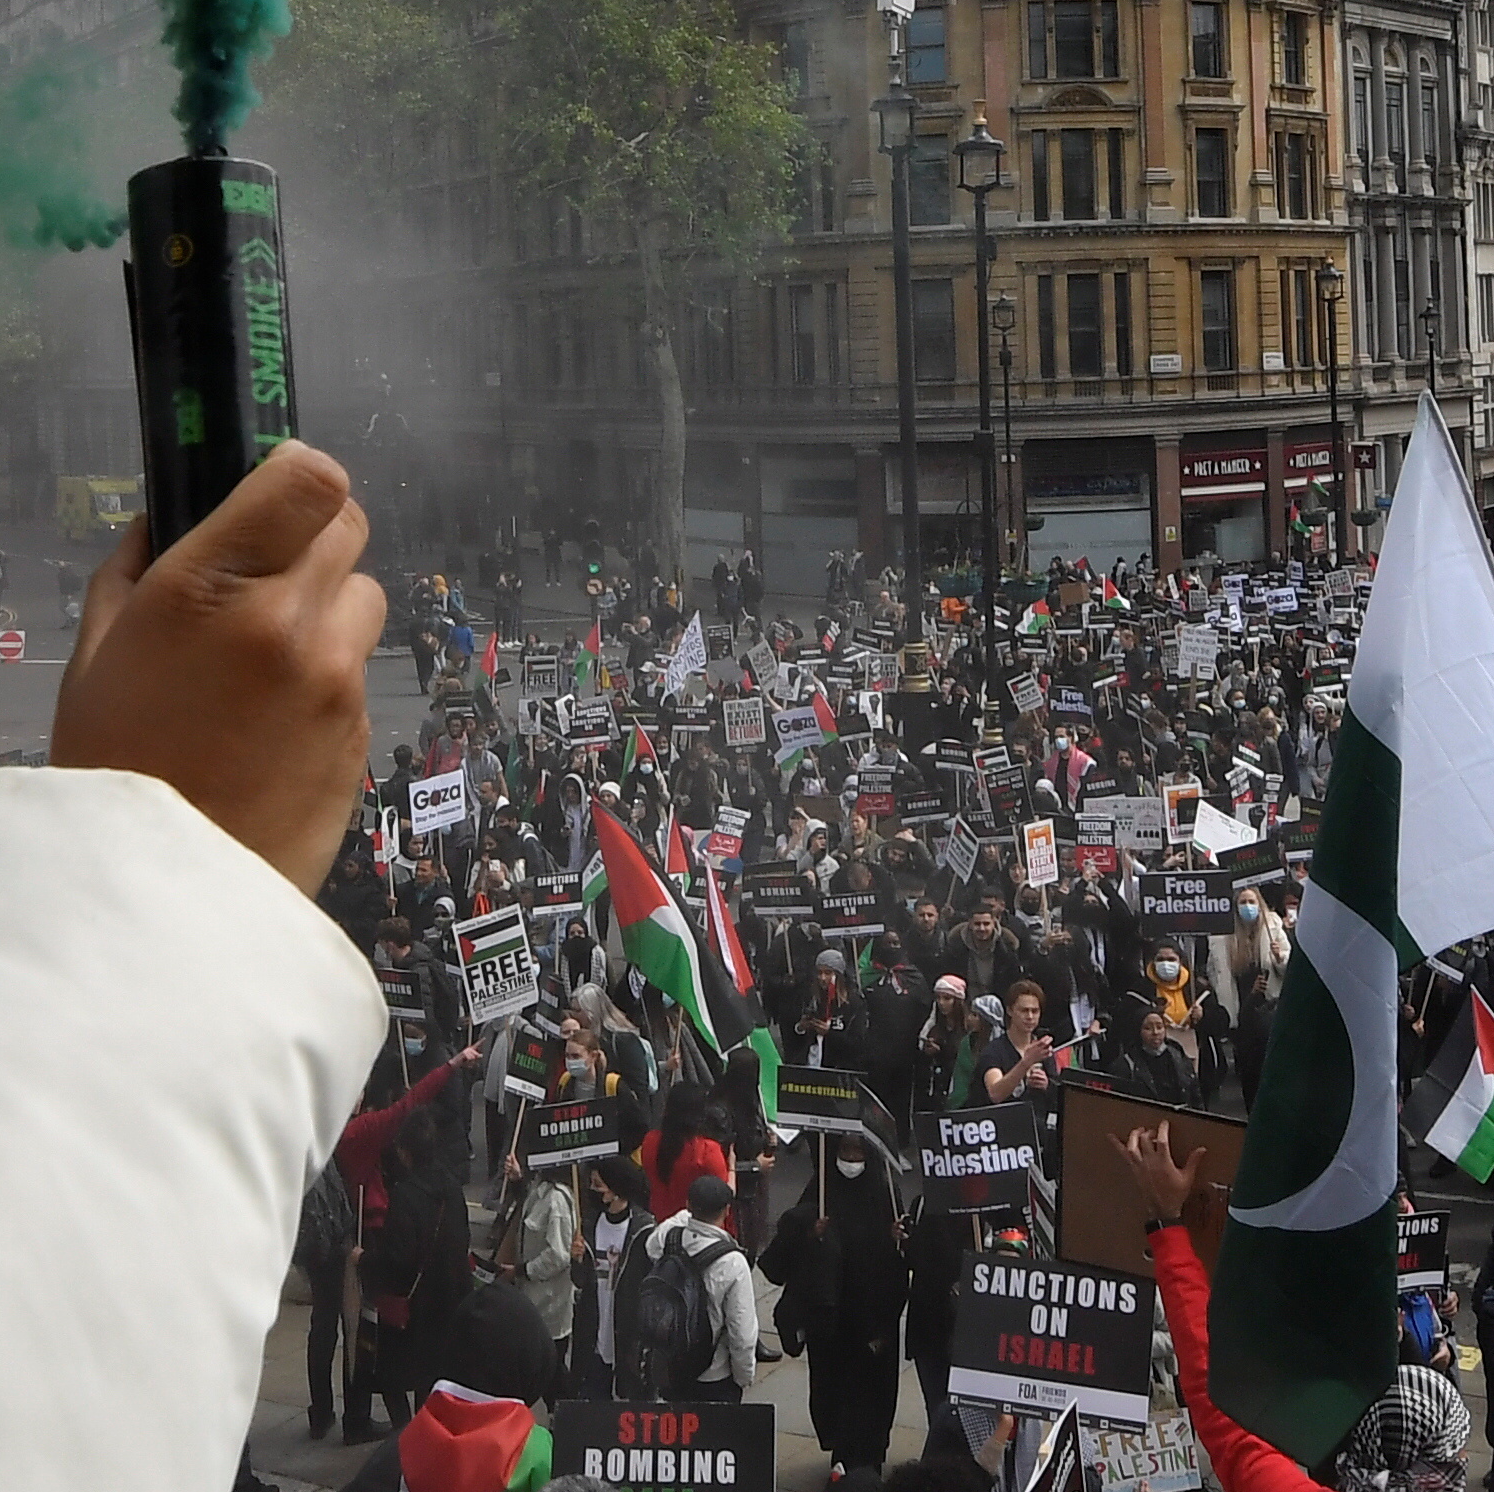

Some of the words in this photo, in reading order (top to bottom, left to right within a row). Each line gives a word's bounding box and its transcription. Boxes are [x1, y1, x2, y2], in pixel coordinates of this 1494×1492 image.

[244, 278, 289, 408] SMOKE
[1193, 460, 1211, 477] PRET
[1213, 460, 1220, 474] A
[1221, 458, 1250, 475] MANGER
[1266, 593, 1294, 607] Gza
[528, 674, 556, 685] FREE
[1060, 687, 1084, 704] Free
[776, 716, 817, 735] Gza
[413, 783, 462, 812] Gza
[1078, 820, 1111, 832] FREEDOM
[1077, 833, 1114, 846] PALESTINE
[537, 873, 579, 887] SANCTIONS
[552, 884, 565, 895] ON
[1164, 876, 1206, 896] Free
[760, 885, 801, 897] BOMBING
[822, 894, 876, 909] SANCTIONS
[1143, 893, 1230, 916] Palestine
[844, 906, 857, 917] ON
[465, 947, 532, 992] FREE
[470, 971, 534, 1004] PALESTINE
[554, 1105, 587, 1121] STOP
[540, 1115, 603, 1137] BOMBING
[938, 1116, 997, 1147] Free
[554, 1131, 588, 1147] GAZA
[922, 1144, 1035, 1178] Palestine
[972, 1263, 1138, 1314] SANCTIONS
[1029, 1304, 1069, 1338] ON
[997, 1333, 1097, 1376] ISRAEL
[1018, 1382, 1038, 1400] FOA
[1041, 1386, 1068, 1398] FRIENDS
[617, 1410, 701, 1445] STOP
[1098, 1420, 1176, 1458] FREE
[584, 1448, 737, 1484] BOMBING
[1095, 1444, 1198, 1485] PALESTINE
